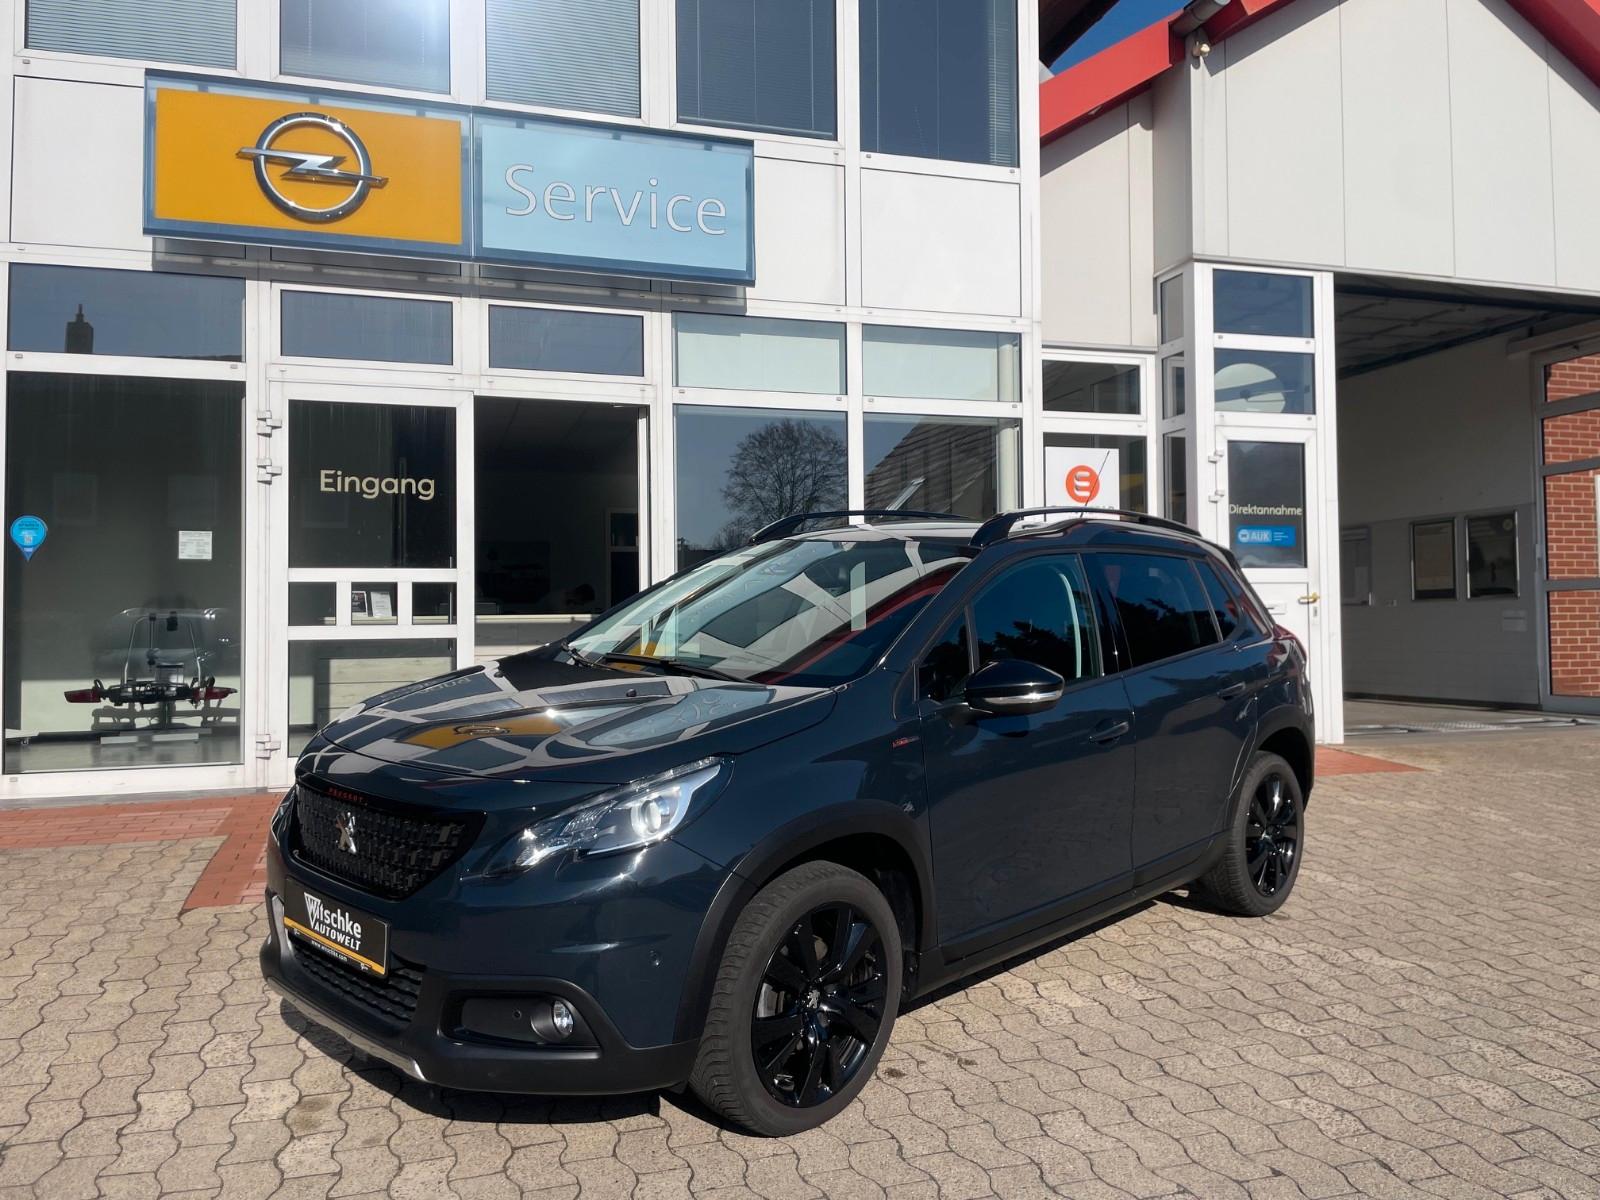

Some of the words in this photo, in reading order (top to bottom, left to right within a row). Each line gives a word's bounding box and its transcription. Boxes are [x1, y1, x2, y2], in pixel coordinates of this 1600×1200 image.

[504, 163, 727, 235] Service
[320, 469, 435, 500] Eingang
[1229, 504, 1303, 515] Direktannahme
[304, 891, 362, 939] Witschke
[314, 922, 361, 951] AUTOWELT
